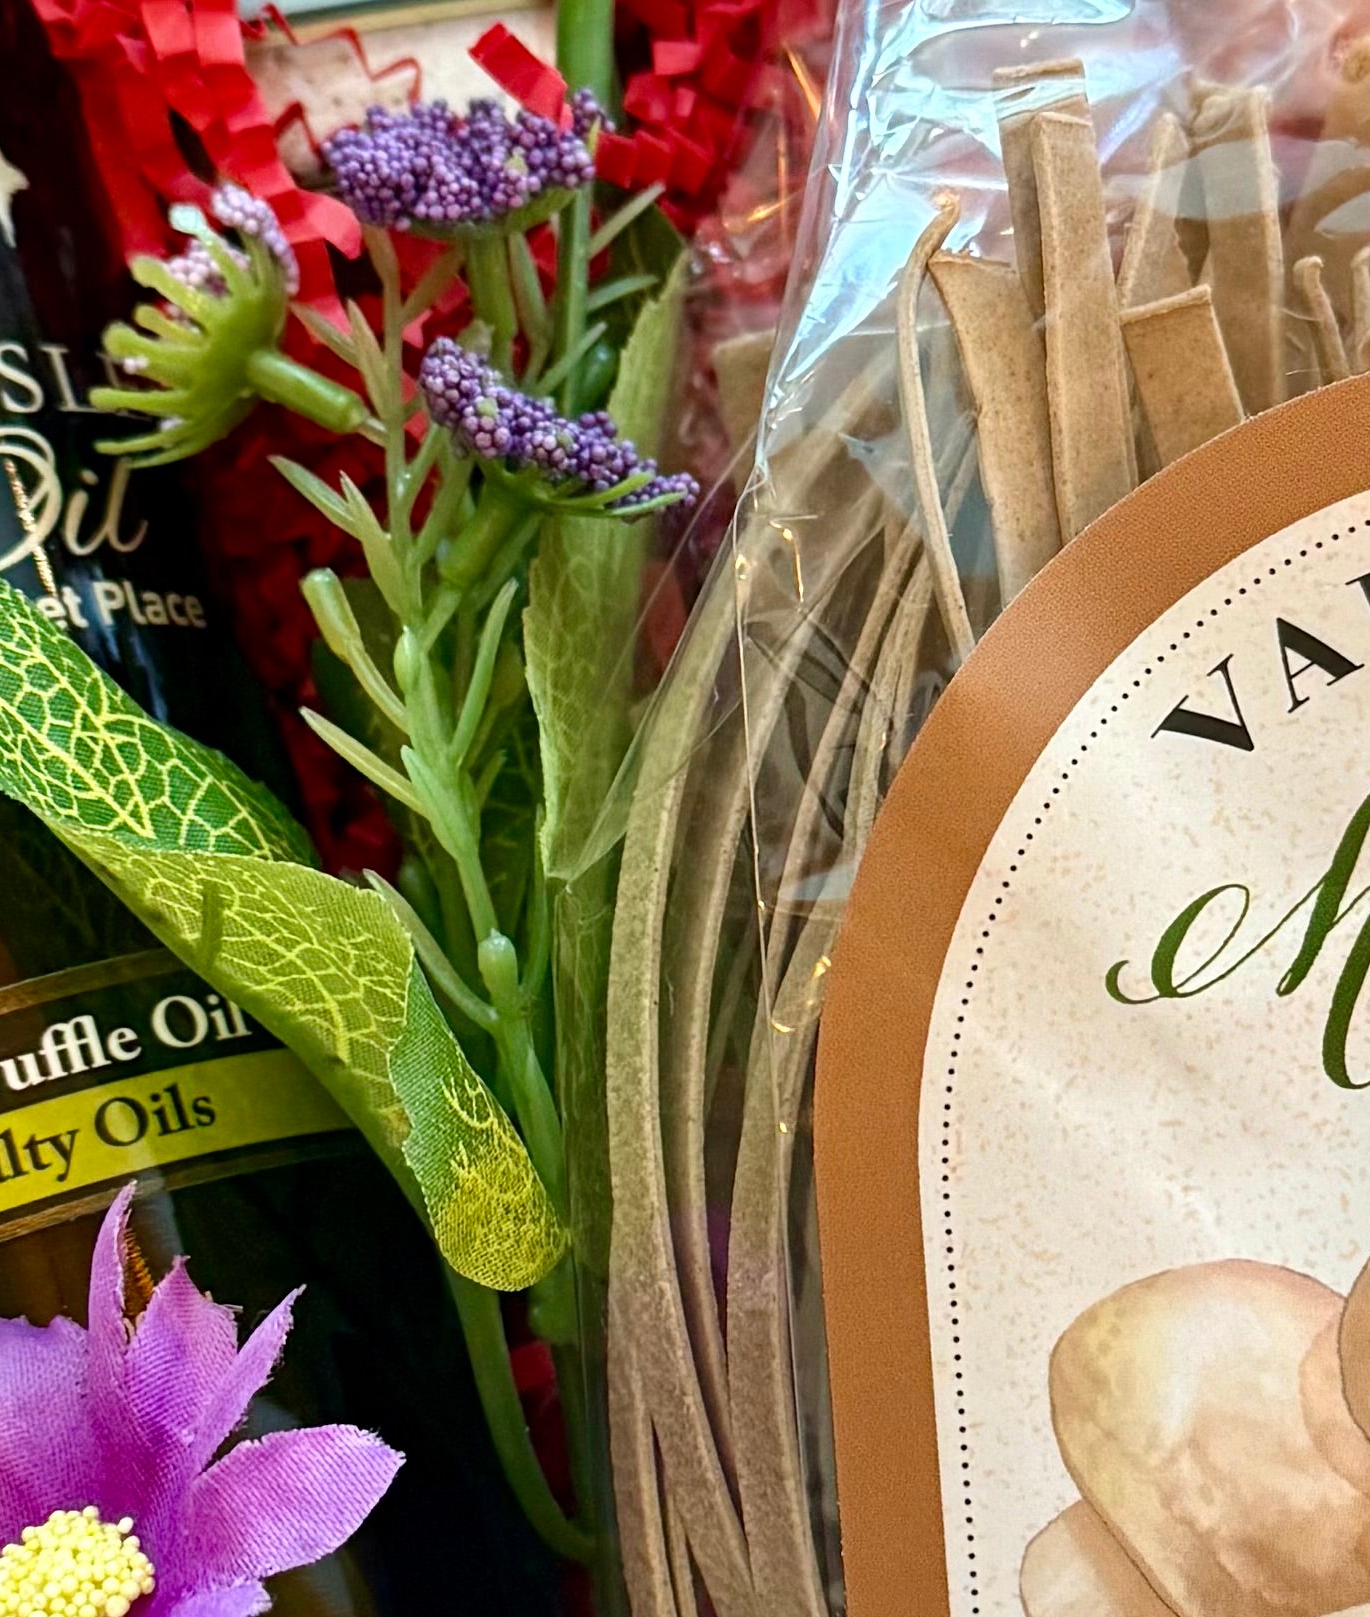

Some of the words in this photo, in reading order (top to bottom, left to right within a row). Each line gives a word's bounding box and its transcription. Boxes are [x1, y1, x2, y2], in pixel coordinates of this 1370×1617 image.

[92, 580, 208, 630] Place
[150, 993, 254, 1049] Oil
[93, 1083, 218, 1150] Oils
